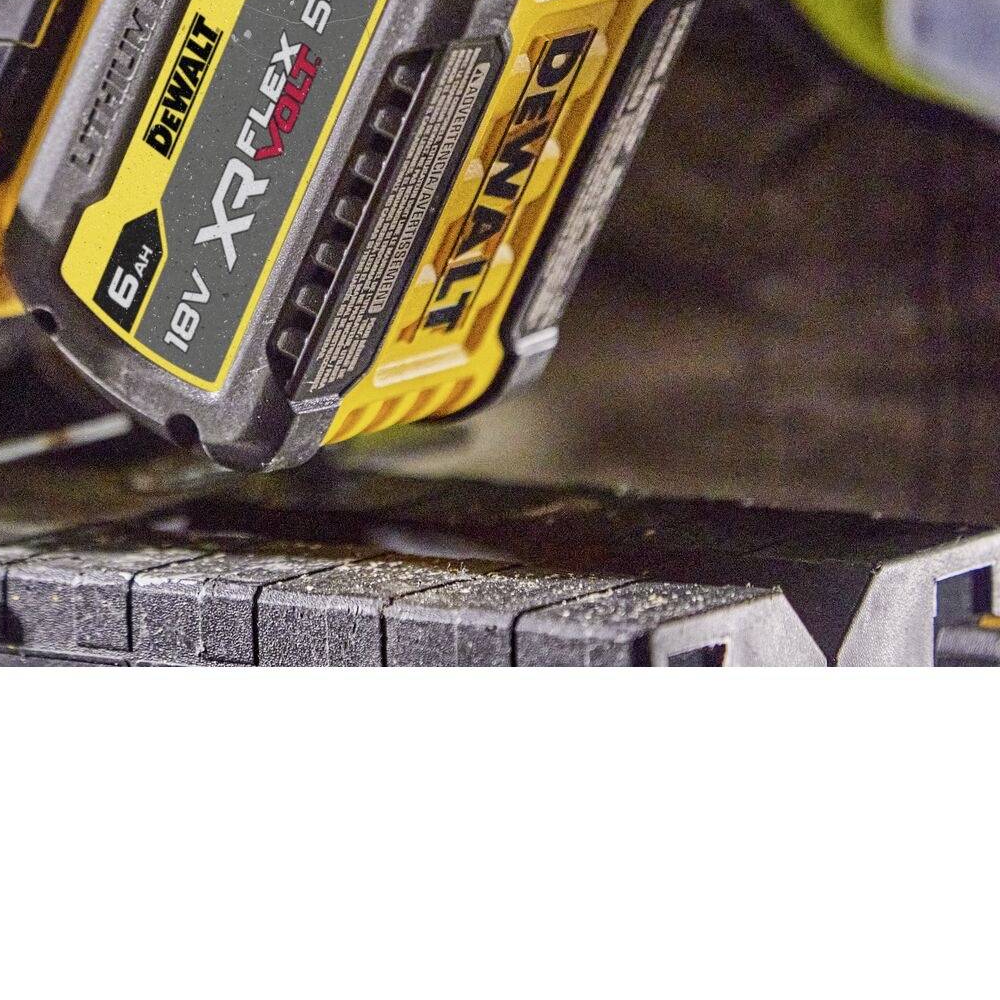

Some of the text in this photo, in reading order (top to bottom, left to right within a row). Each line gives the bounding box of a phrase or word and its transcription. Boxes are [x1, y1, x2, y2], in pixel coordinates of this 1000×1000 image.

[70, 6, 156, 177] LITHIUM
[254, 43, 319, 162] VOLT
[164, 267, 210, 352] 18V
[194, 158, 270, 272] XR
[235, 30, 302, 159] FLEX
